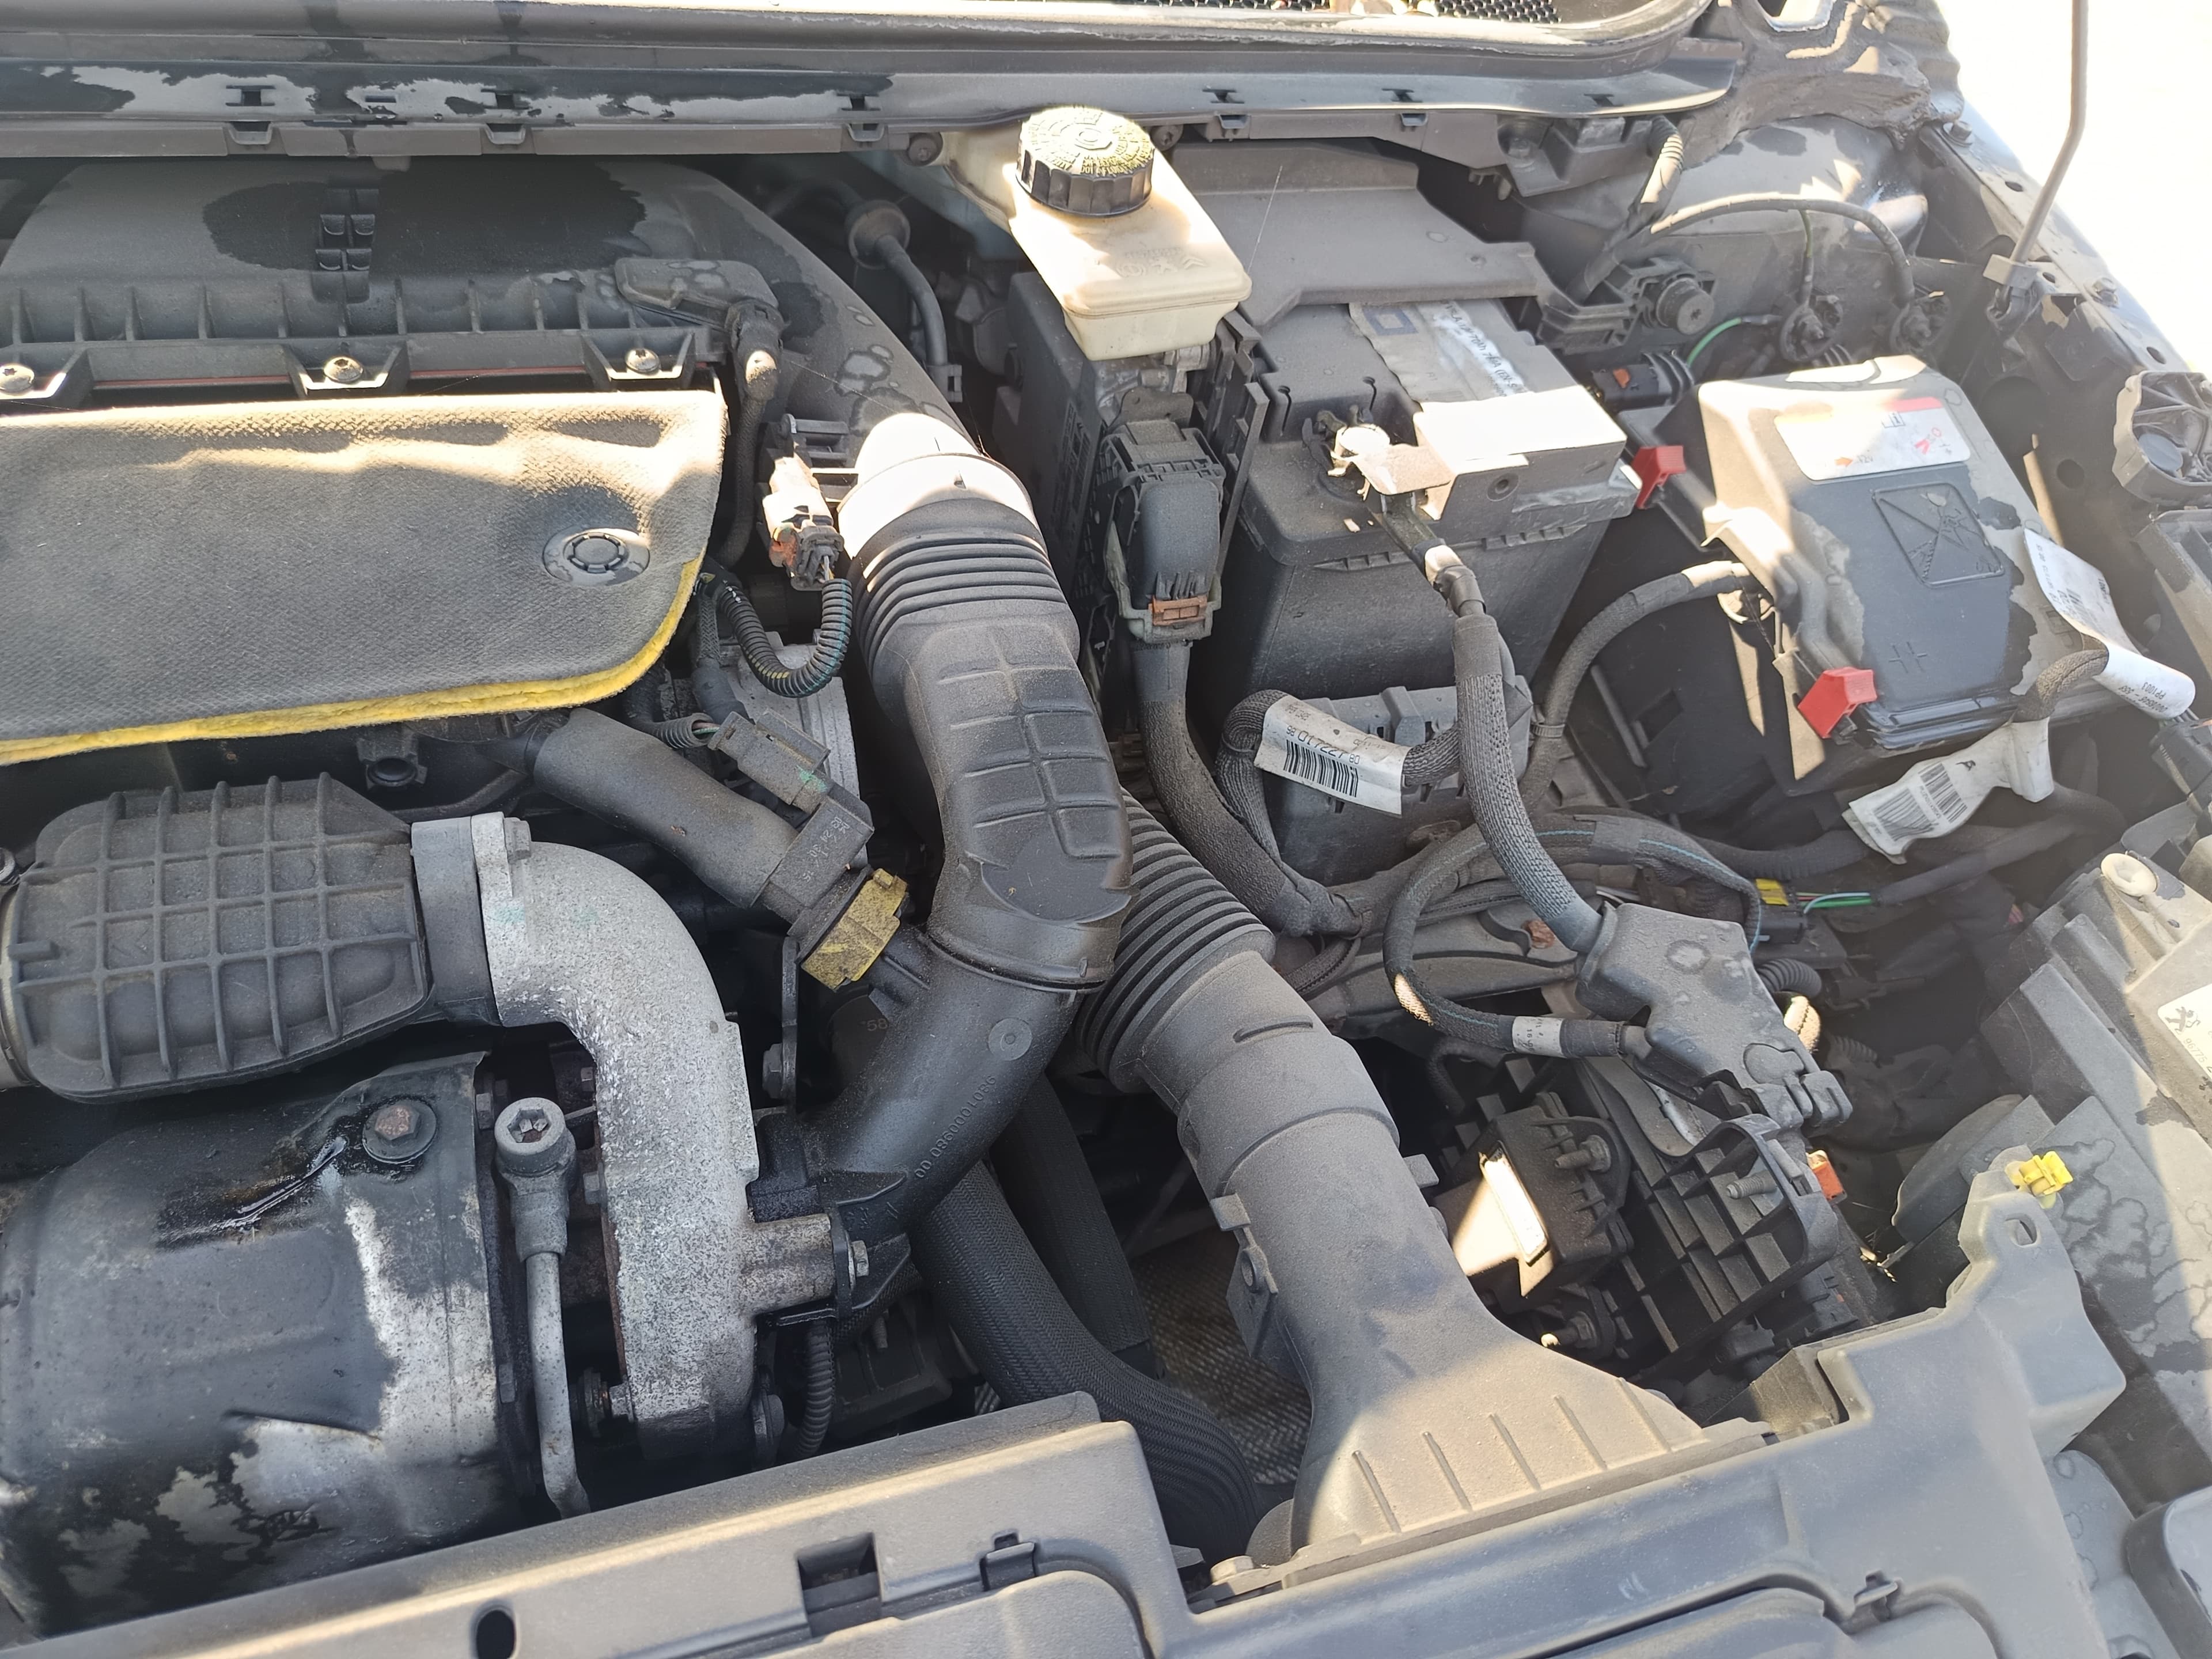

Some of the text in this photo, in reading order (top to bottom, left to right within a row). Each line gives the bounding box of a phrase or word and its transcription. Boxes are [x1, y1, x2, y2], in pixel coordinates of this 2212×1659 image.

[2142, 680, 2166, 700] PP1003
[1297, 730, 1349, 759] 017227
[1348, 753, 1361, 765] 80
